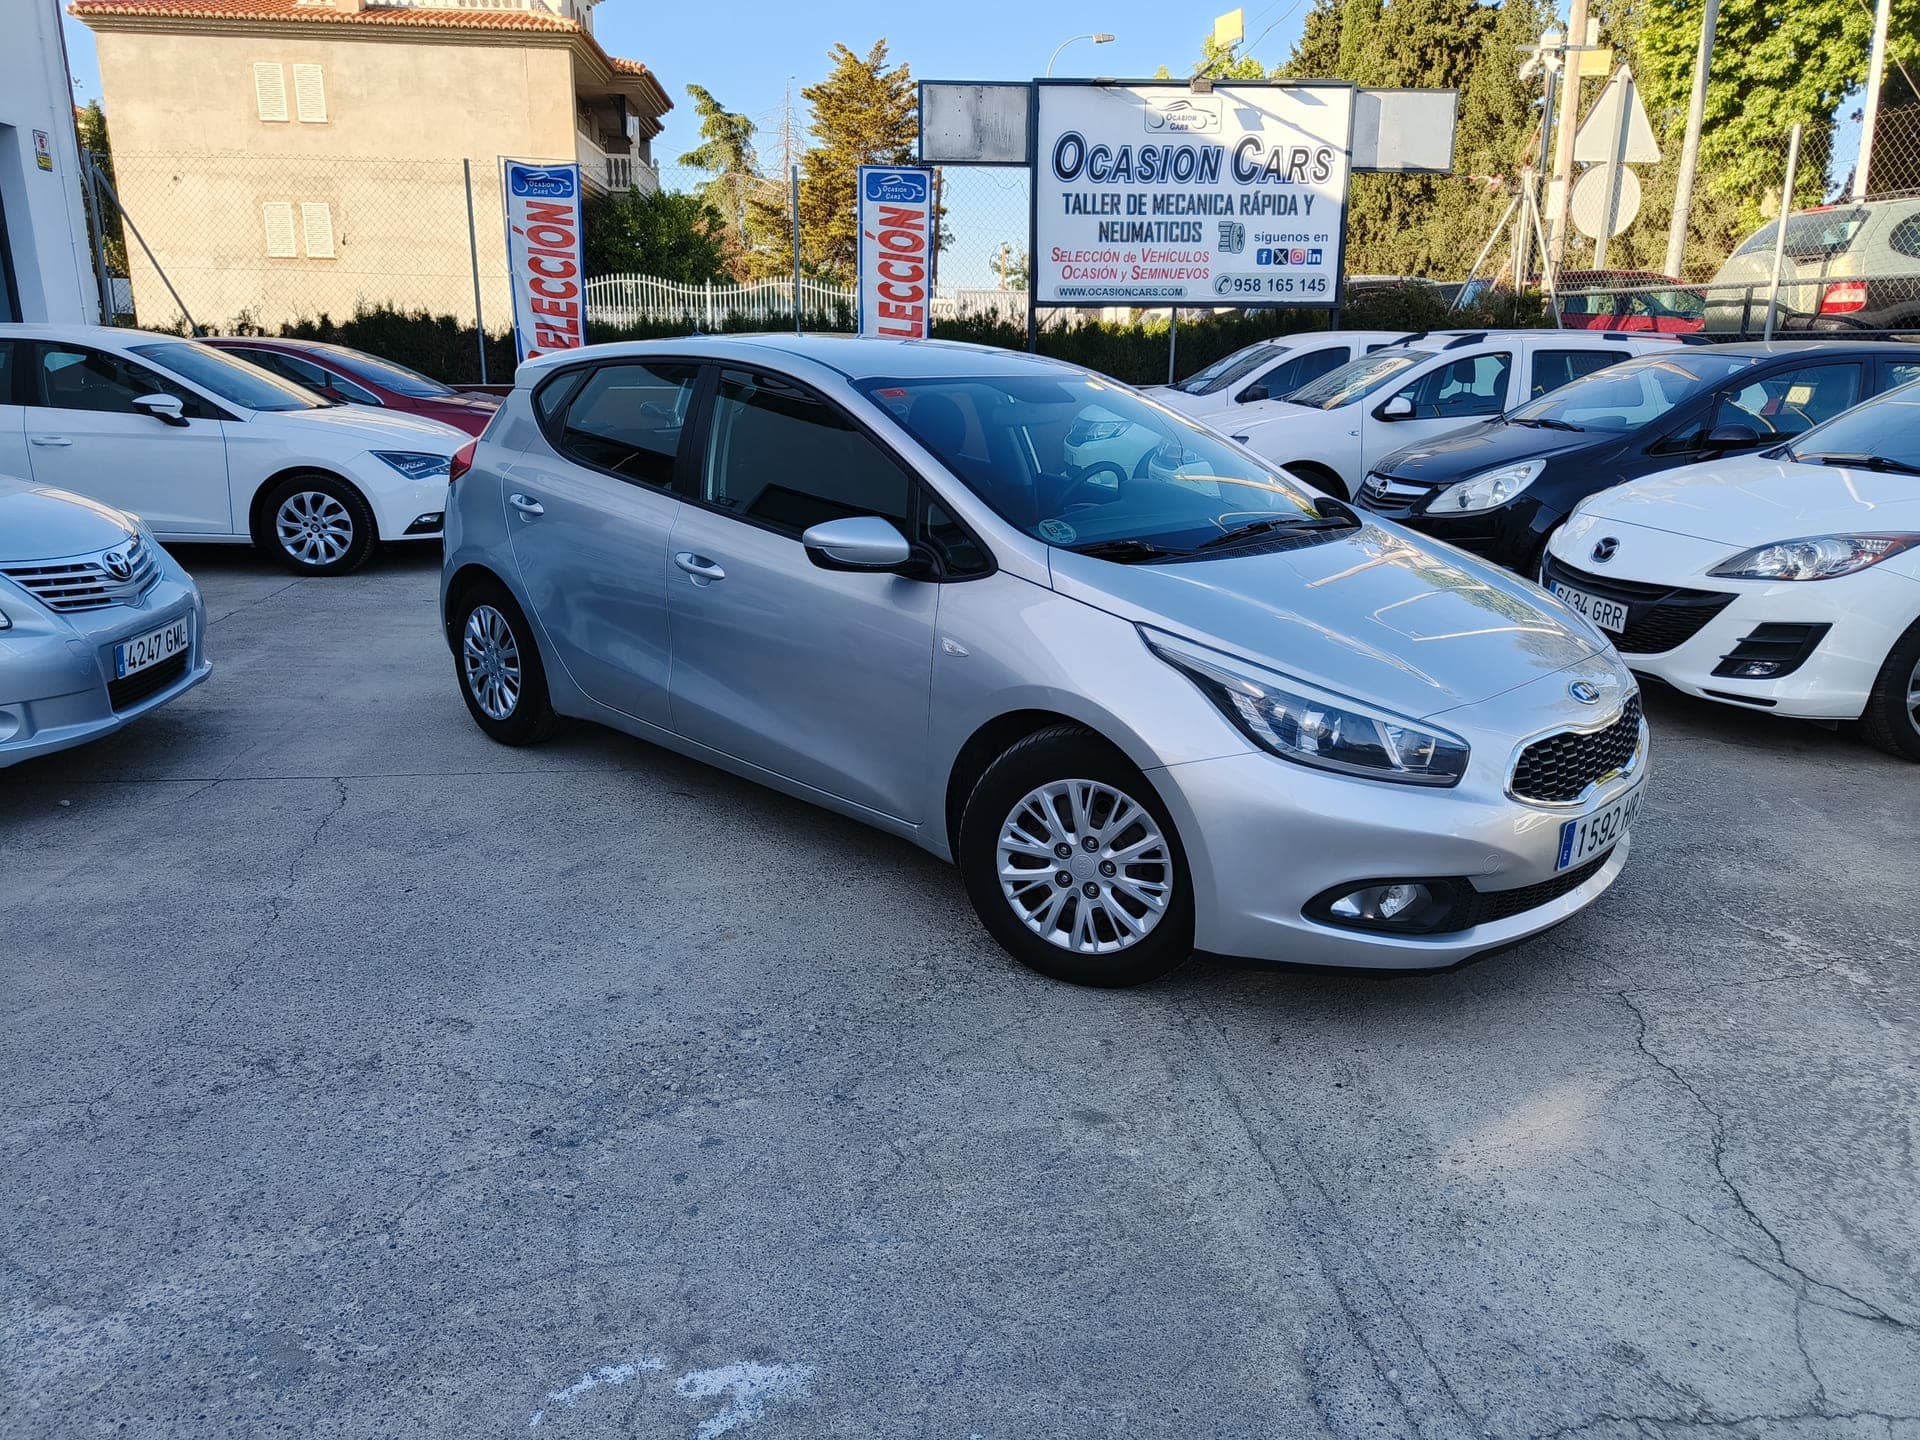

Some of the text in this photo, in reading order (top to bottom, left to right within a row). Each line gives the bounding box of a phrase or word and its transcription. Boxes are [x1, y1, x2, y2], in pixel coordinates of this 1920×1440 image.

[1052, 130, 1335, 185] OCASION CARS
[1062, 190, 1315, 216] TALLER DE MECANICA RÁPIDA Y
[1098, 221, 1203, 243] NEUMATICOS
[1313, 233, 1329, 242] en
[1050, 246, 1210, 263] SELECCIÓN de VEHÍCULOS
[512, 200, 581, 359] ELECCIÓN
[864, 205, 925, 339] LECCIÓN
[1061, 264, 1210, 283] OCASIÓN y SEMINUEVOS
[1234, 278, 1326, 292] 958 165 145
[1059, 287, 1183, 297] WWW.OCASIONCARS.COM
[1592, 600, 1623, 629] GRR
[128, 634, 162, 669] 4247
[165, 623, 186, 653] GML
[1577, 806, 1621, 857] 1592
